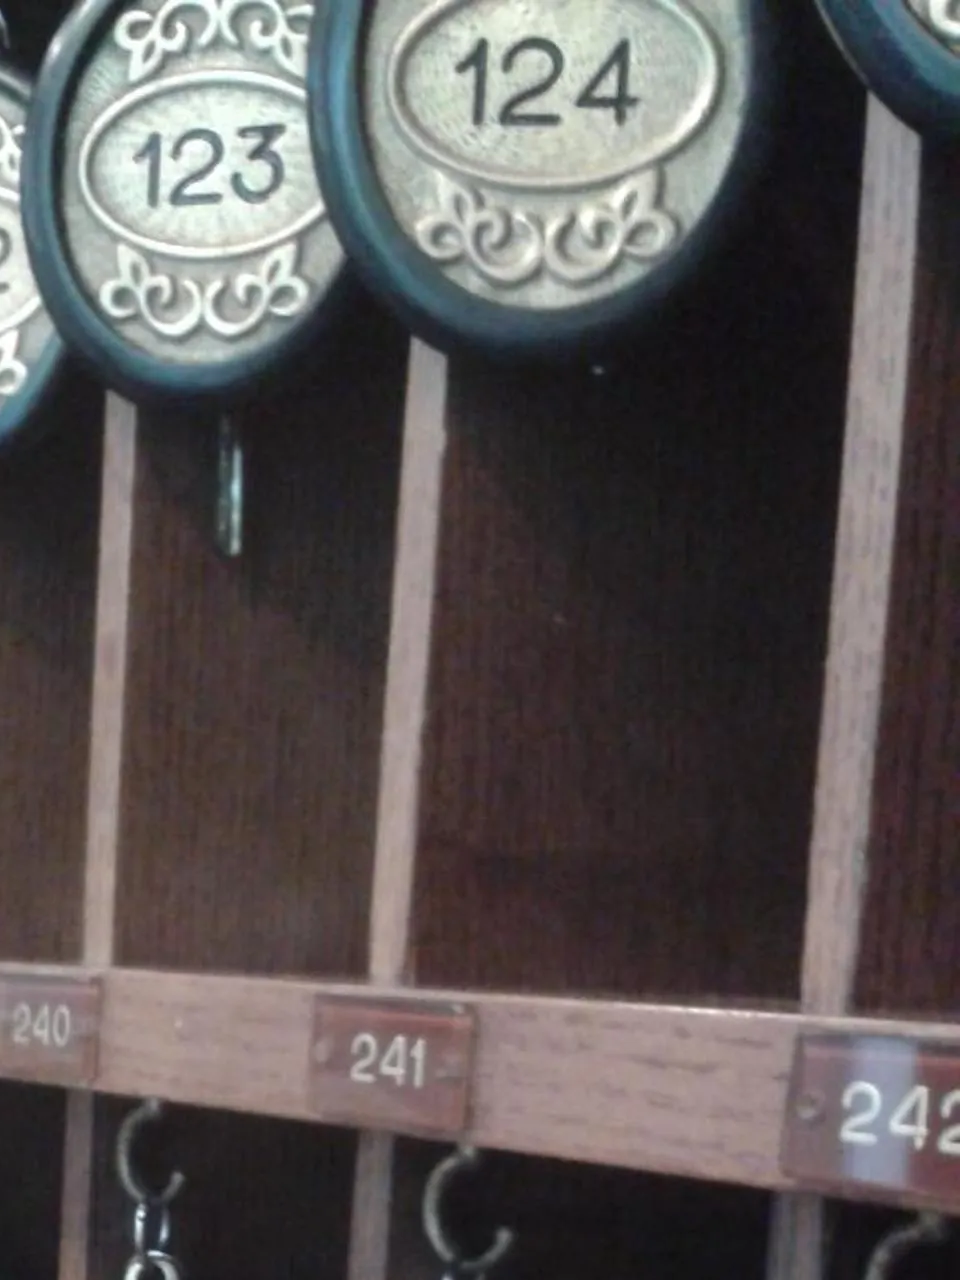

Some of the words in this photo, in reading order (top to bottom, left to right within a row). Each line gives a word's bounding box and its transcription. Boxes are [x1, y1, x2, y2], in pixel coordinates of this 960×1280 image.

[455, 37, 639, 127] 124
[133, 123, 287, 209] 123
[12, 1001, 71, 1048] 240
[350, 1032, 427, 1089] 241
